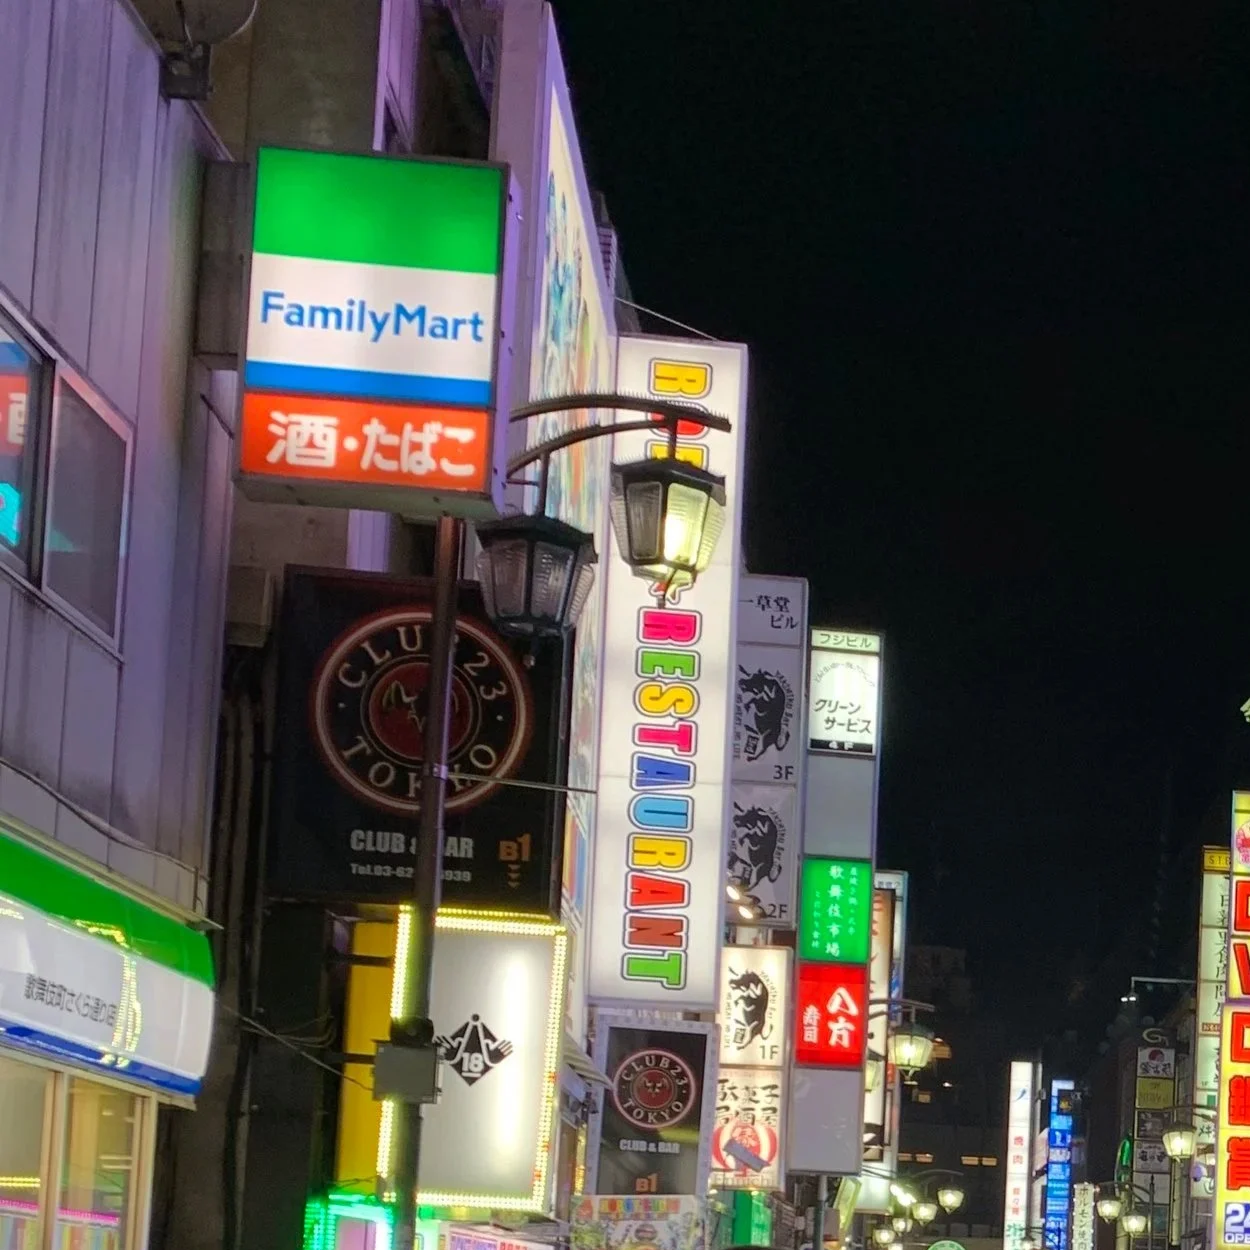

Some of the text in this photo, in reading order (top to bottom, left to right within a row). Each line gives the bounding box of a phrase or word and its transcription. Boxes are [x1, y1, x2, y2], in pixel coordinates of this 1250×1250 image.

[260, 291, 485, 344] FamilyMart
[266, 411, 477, 476] 酒・たばこ
[770, 614, 798, 630] ビル
[818, 632, 873, 648] フジビル
[814, 698, 861, 715] クリーン
[824, 716, 872, 734] サービス
[773, 765, 794, 780] 3F
[621, 606, 703, 990] RESTAURANT
[351, 829, 405, 853] CLUB
[500, 834, 531, 861] B1
[767, 904, 788, 919] 2F
[827, 987, 859, 1048] 八方
[461, 1052, 484, 1073] 18
[760, 1045, 779, 1060] 1F
[622, 1098, 688, 1125] TOKYO
[619, 1138, 647, 1152] CLUB
[658, 1140, 681, 1154] BAR
[636, 1173, 658, 1193] B1
